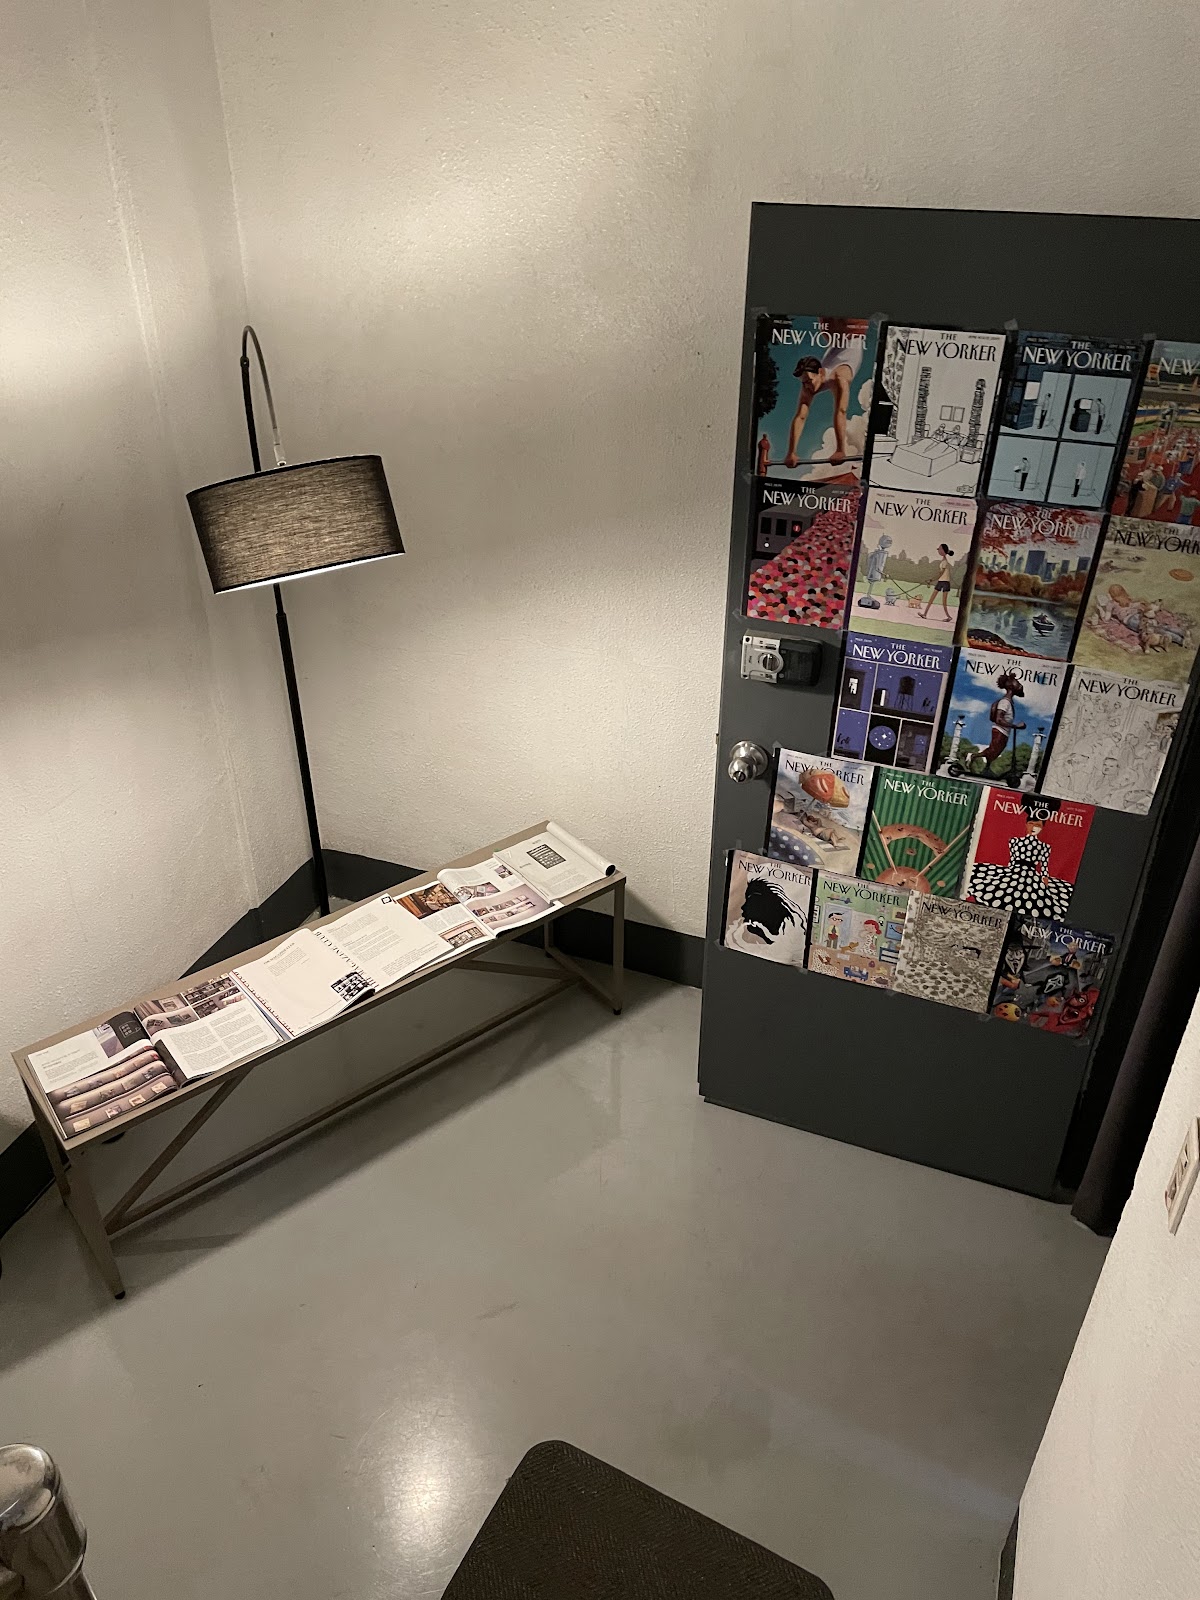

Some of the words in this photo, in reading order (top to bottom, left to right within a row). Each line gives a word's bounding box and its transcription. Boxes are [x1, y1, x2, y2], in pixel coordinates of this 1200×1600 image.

[813, 322, 830, 331] THE
[940, 332, 957, 341] THE
[771, 328, 807, 345] NEW
[808, 331, 867, 350] YORKER
[897, 338, 932, 356] NEW
[935, 342, 996, 362] YORKER
[1070, 341, 1091, 350] THE
[1022, 347, 1064, 365] NEW
[1066, 351, 1131, 372] YORKER
[1159, 357, 1200, 376] NEW
[762, 490, 796, 506] NEW
[797, 493, 851, 514] YORKER
[801, 486, 816, 494] THE
[915, 498, 931, 506] THE
[873, 501, 909, 517] NEW
[910, 505, 968, 525] YORKER
[991, 514, 1028, 531] NEW
[1030, 516, 1090, 539] YORKER
[1114, 529, 1155, 548] NEW
[852, 644, 886, 660] NEW
[886, 649, 940, 669] YORKER
[1007, 659, 1022, 667] THE
[965, 660, 1000, 676] NEW
[1002, 665, 1058, 687] YORKER
[1078, 678, 1116, 694] NEW
[1117, 683, 1176, 707] YORKER
[884, 778, 915, 794] NEW
[917, 785, 968, 807] YORKER
[922, 780, 936, 788] THE
[993, 800, 1027, 815] NEW
[1028, 806, 1083, 828] YORKER
[1034, 800, 1049, 809] THE
[738, 860, 765, 873] NEW
[766, 866, 811, 886] YORKER
[823, 880, 851, 894] NEW
[853, 886, 900, 906] YORKER
[921, 901, 952, 916] NEW
[953, 907, 1002, 929] YORKER
[1021, 923, 1053, 939] NEW
[1054, 932, 1106, 955] YORKER
